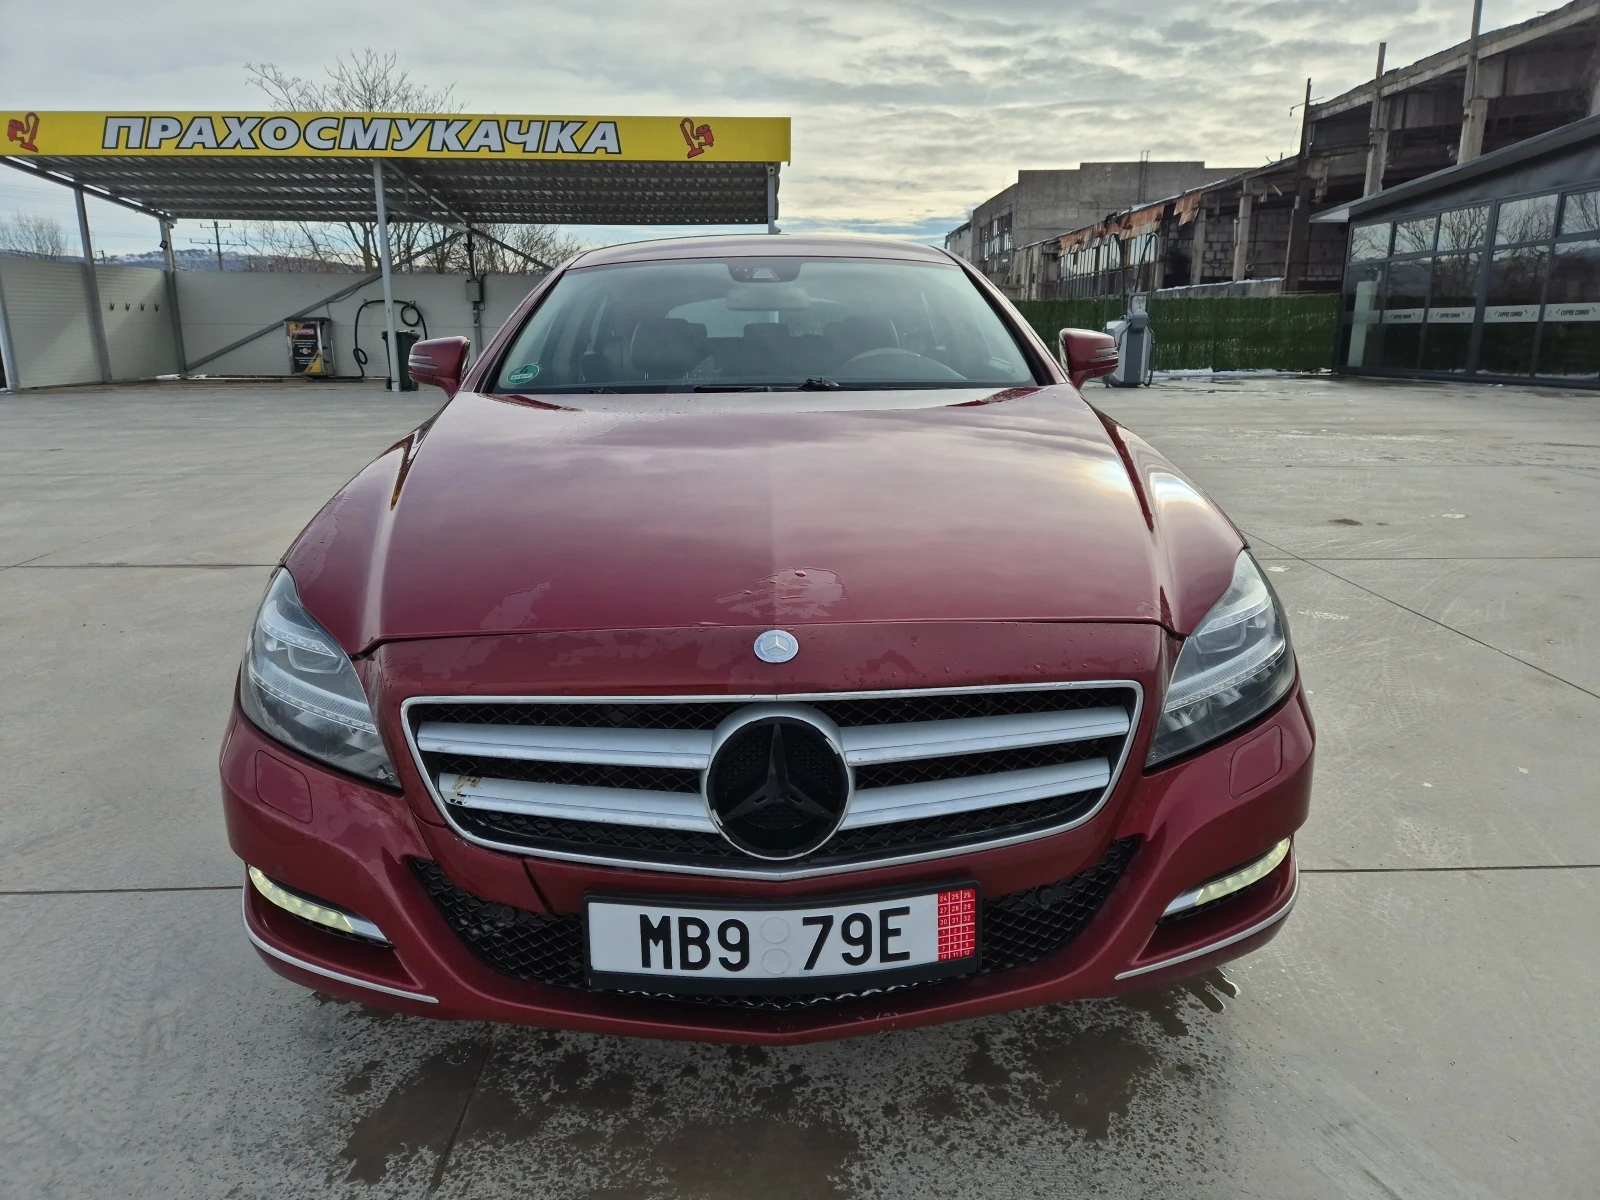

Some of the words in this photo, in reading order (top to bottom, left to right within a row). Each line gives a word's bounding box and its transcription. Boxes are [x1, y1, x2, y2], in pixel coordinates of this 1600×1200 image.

[102, 116, 622, 154] ПРАХОСМУКАЧКА
[639, 913, 750, 972] MB9
[802, 906, 911, 970] 79E
